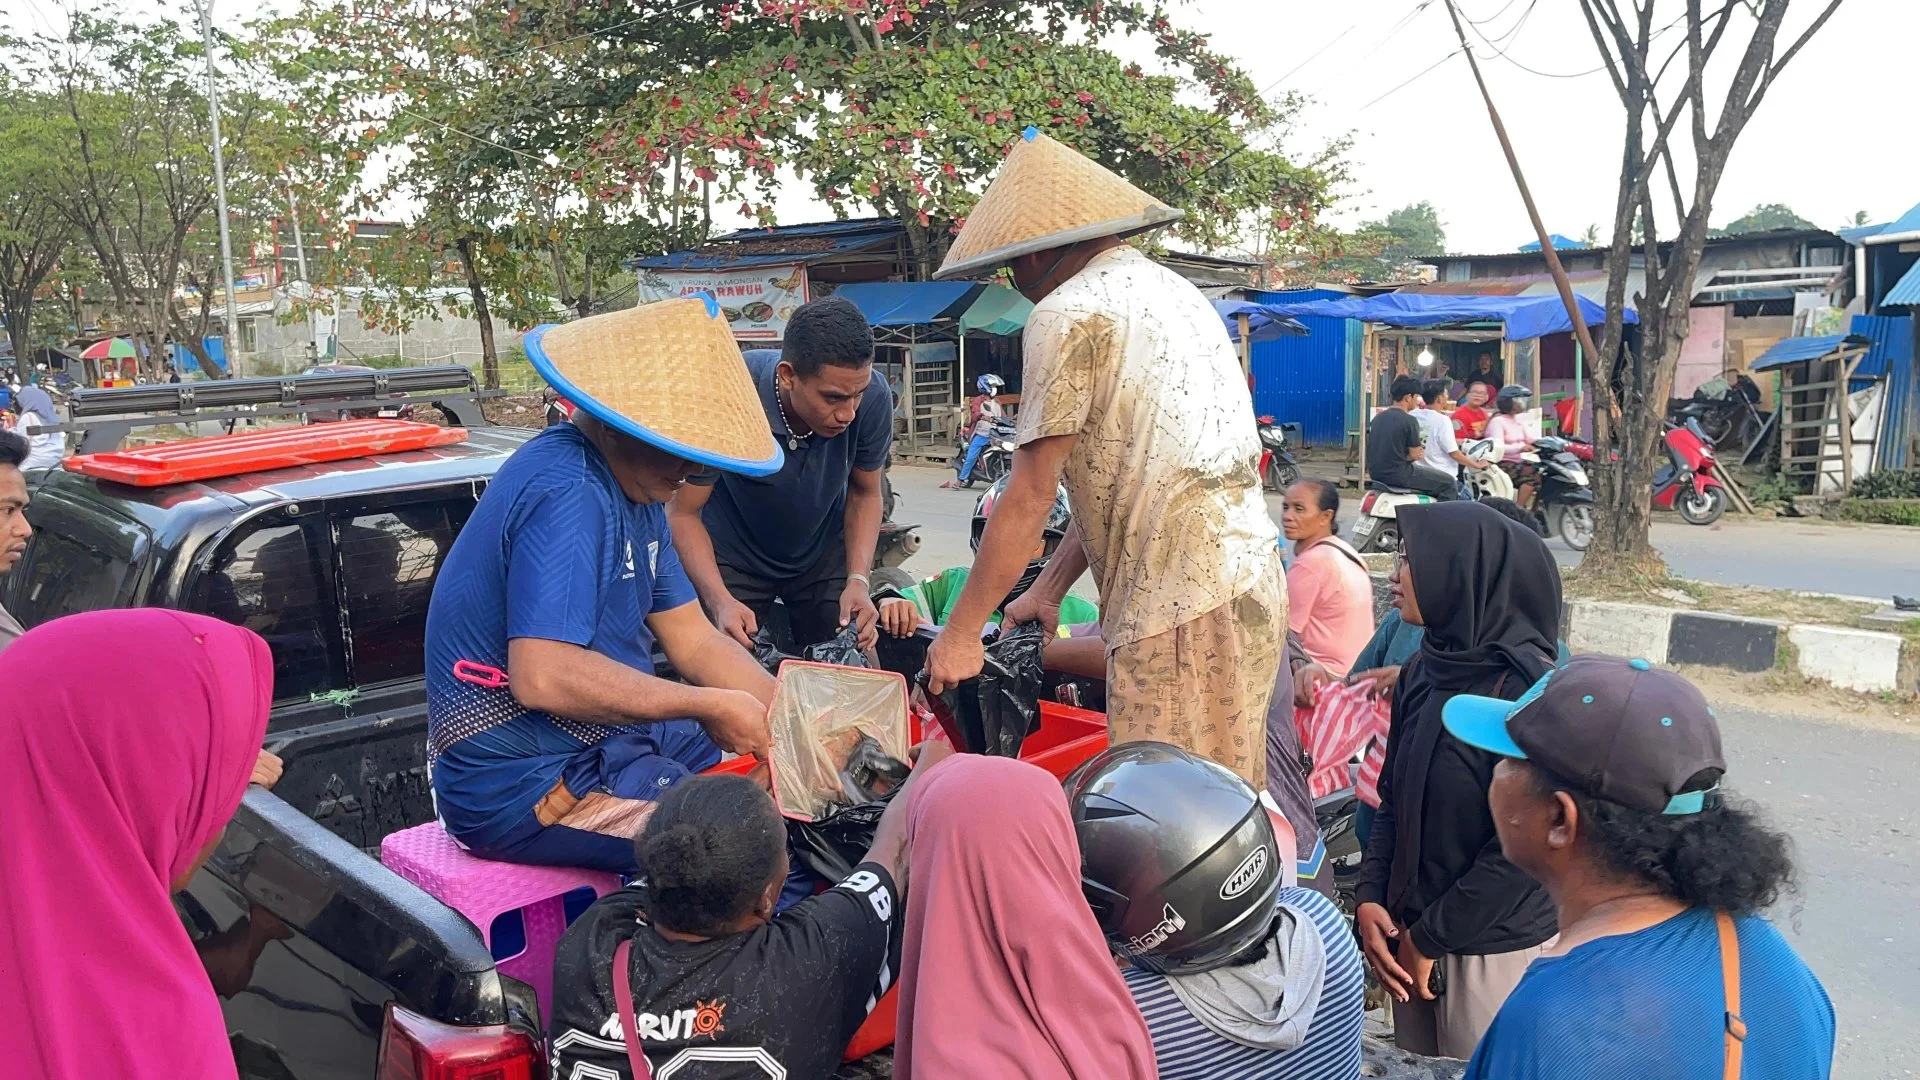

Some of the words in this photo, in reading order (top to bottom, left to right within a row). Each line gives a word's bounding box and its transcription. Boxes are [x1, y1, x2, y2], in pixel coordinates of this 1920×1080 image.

[714, 277, 763, 286] LAMONGAN
[716, 284, 763, 297] RAWUH
[1231, 852, 1262, 891] HMR
